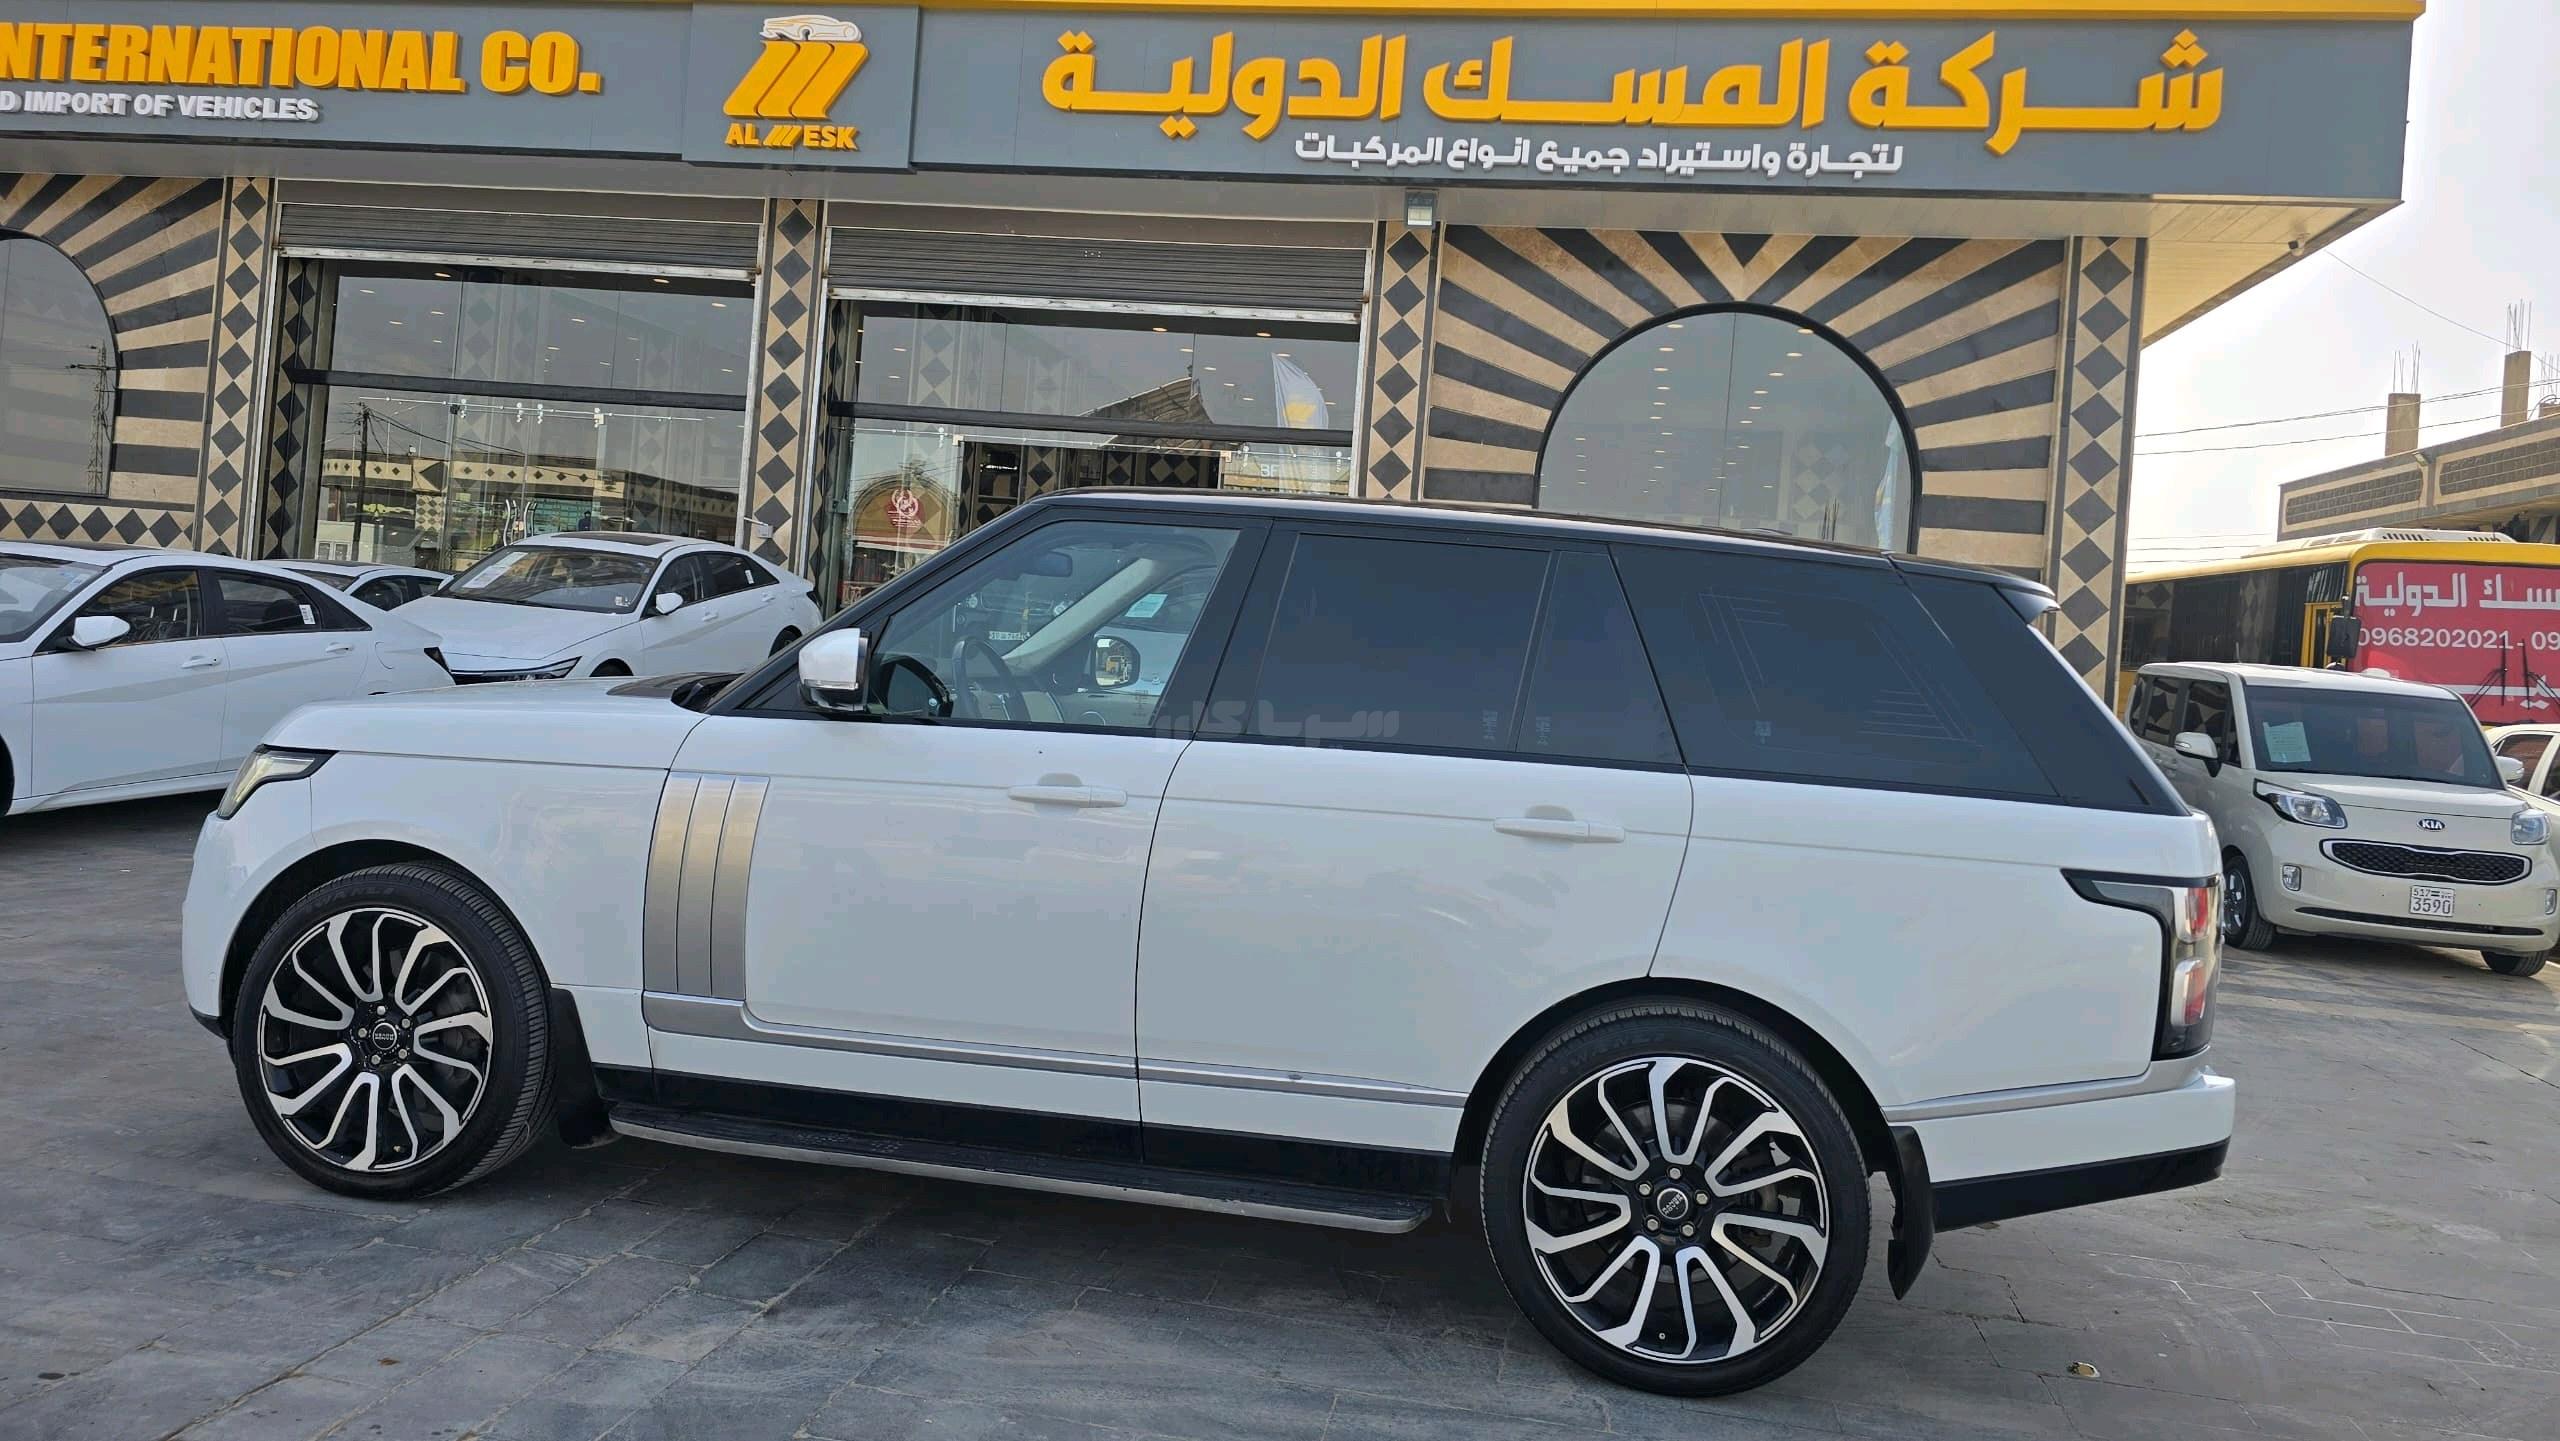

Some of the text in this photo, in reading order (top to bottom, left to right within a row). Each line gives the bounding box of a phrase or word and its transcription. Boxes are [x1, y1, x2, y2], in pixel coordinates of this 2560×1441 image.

[480, 30, 602, 95] CO.
[24, 90, 131, 116] IMPORT
[133, 93, 175, 117] OF
[177, 94, 319, 121] VEHICLES
[1042, 28, 2224, 156] شركة المسك الدولية
[724, 122, 762, 148] AL
[1295, 132, 1904, 180] لتجارة واستيراد جميع انواع المركبات
[2354, 570, 2468, 617] الدولية
[2358, 627, 2514, 650] 0968202021
[2421, 819, 2443, 830] KIA
[2412, 898, 2452, 915] 3590
